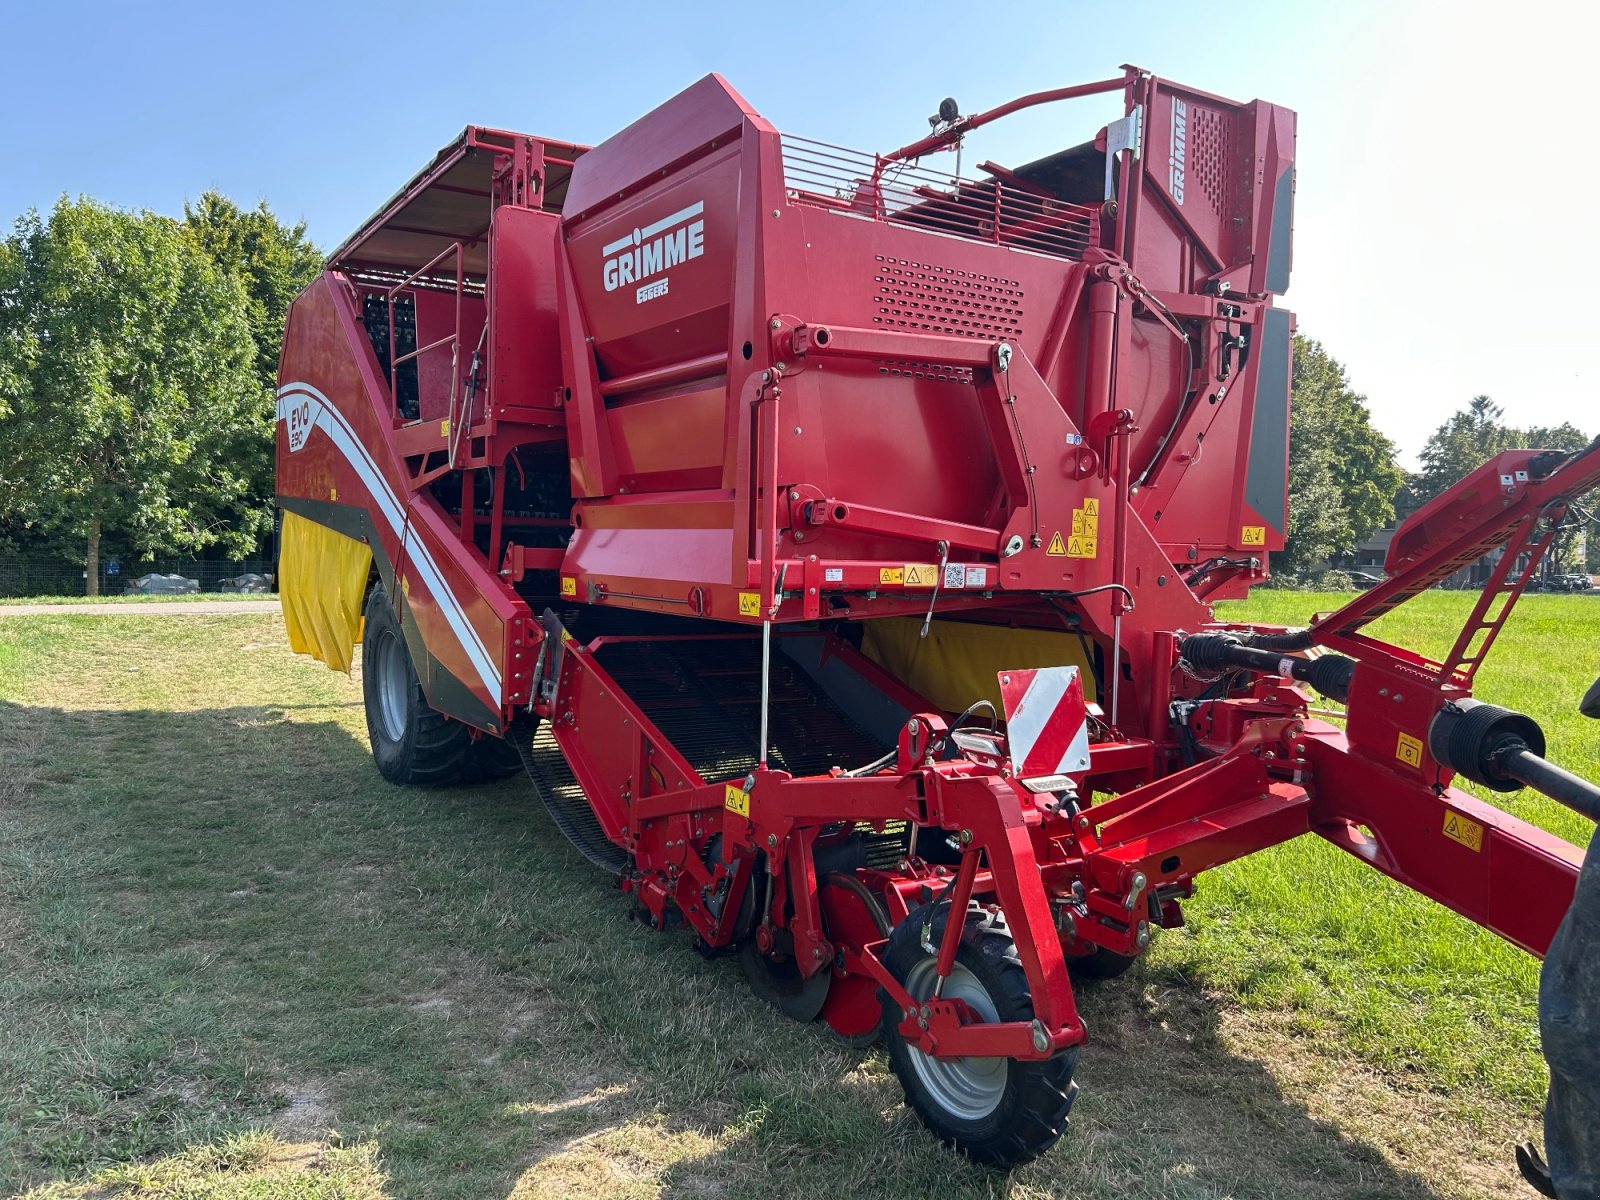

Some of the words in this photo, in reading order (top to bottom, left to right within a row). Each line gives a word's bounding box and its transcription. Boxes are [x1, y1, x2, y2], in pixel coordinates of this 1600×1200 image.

[1170, 97, 1187, 206] GRIMME
[603, 219, 704, 292] GRIMME
[636, 278, 669, 305] EGGERS
[291, 401, 309, 431] EVO
